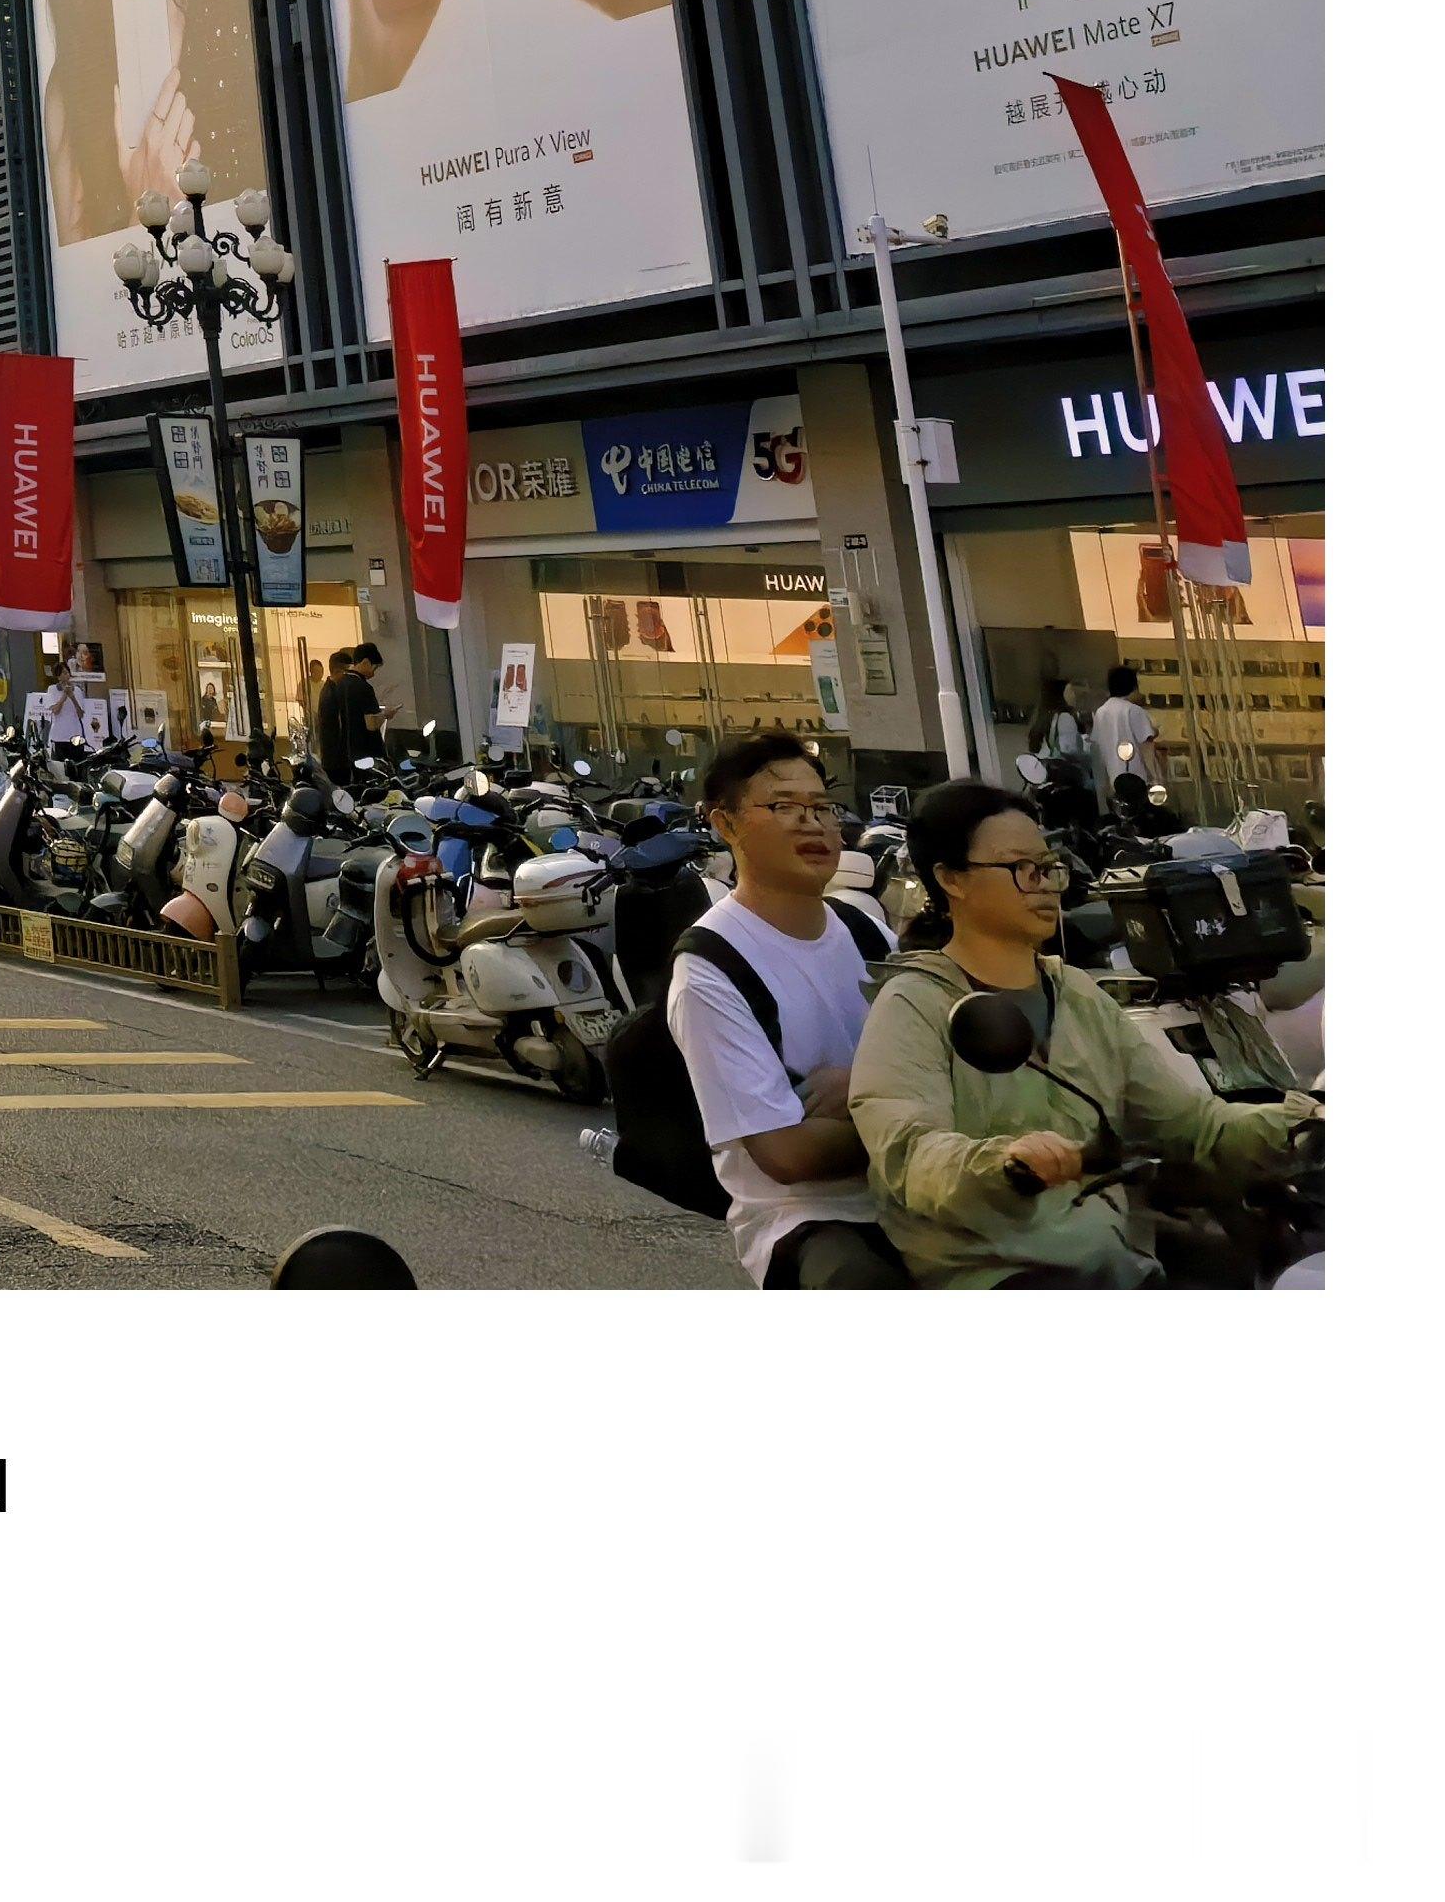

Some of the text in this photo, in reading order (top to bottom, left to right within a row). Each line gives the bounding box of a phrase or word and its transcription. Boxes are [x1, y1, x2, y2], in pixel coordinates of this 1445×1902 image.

[974, 1, 1174, 72] HUAWEI Mate X7
[420, 149, 490, 186] HUAWEI
[495, 144, 531, 168] Pura
[534, 135, 547, 159] X
[549, 128, 592, 154] View
[456, 183, 565, 234] 阔有新意
[230, 326, 274, 349] ColorOS
[1060, 367, 1325, 458] HUWE
[416, 354, 446, 534] HUAWEI
[638, 440, 716, 482] 中国电信
[752, 427, 806, 485] 5G
[13, 423, 38, 560] HUAWEI
[467, 457, 577, 503] OR 荣耀
[640, 478, 720, 495] CHINA TELECOM
